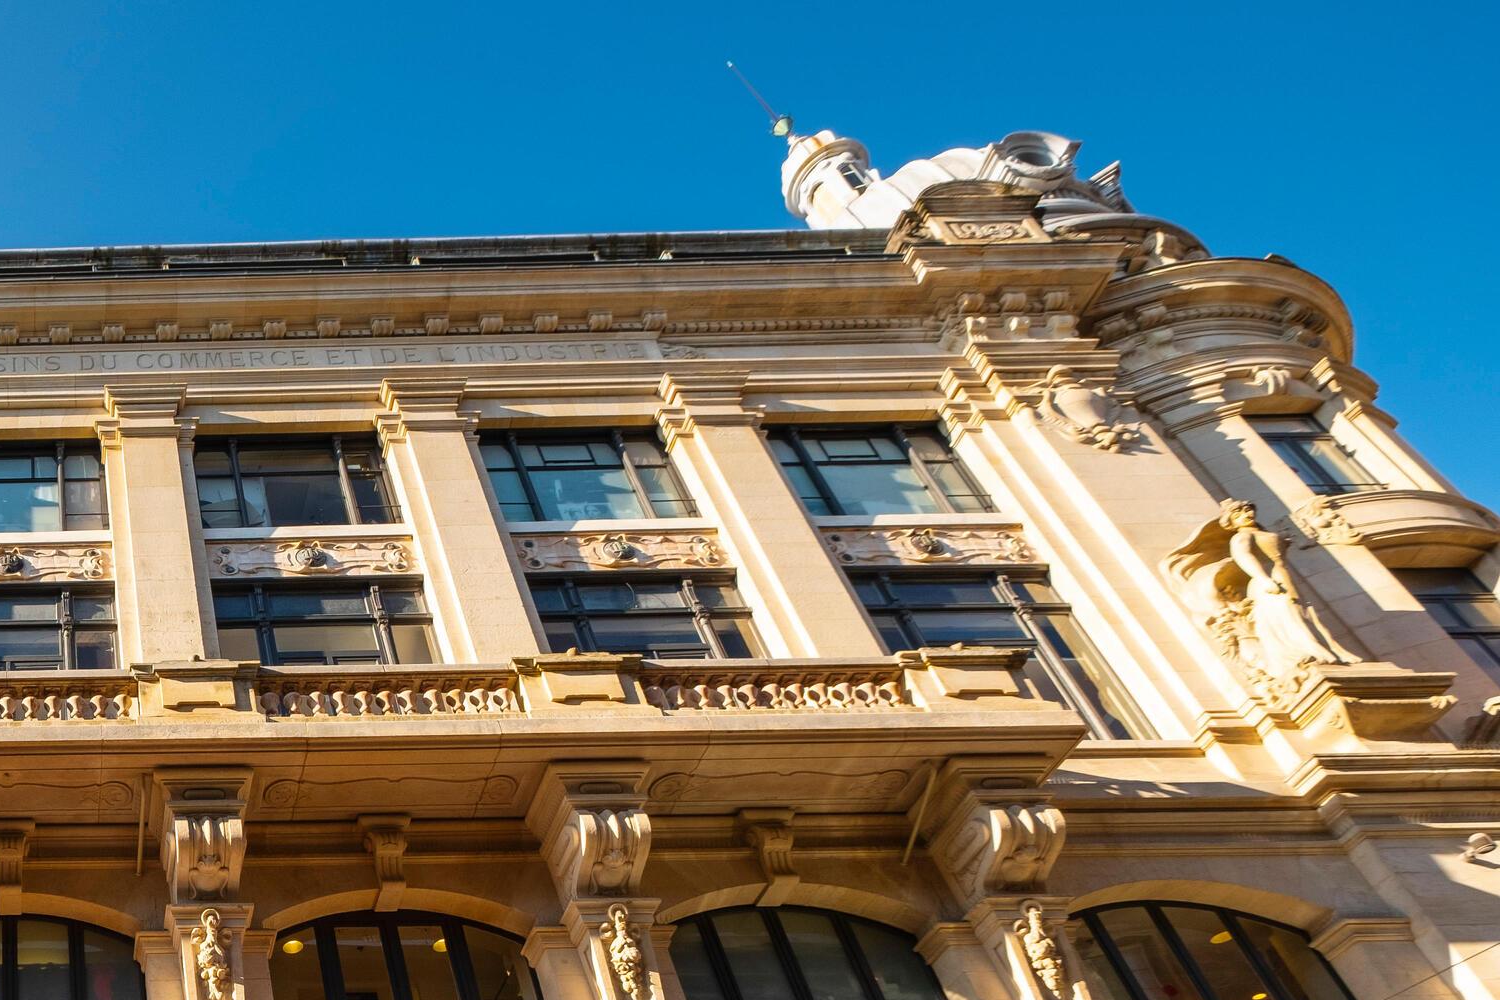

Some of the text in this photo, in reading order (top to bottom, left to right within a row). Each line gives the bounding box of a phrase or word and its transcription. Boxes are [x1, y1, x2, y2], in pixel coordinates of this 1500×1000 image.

[79, 354, 117, 372] DU
[136, 349, 310, 370] COMMERCE
[326, 349, 363, 366] ET
[380, 347, 422, 364] DE
